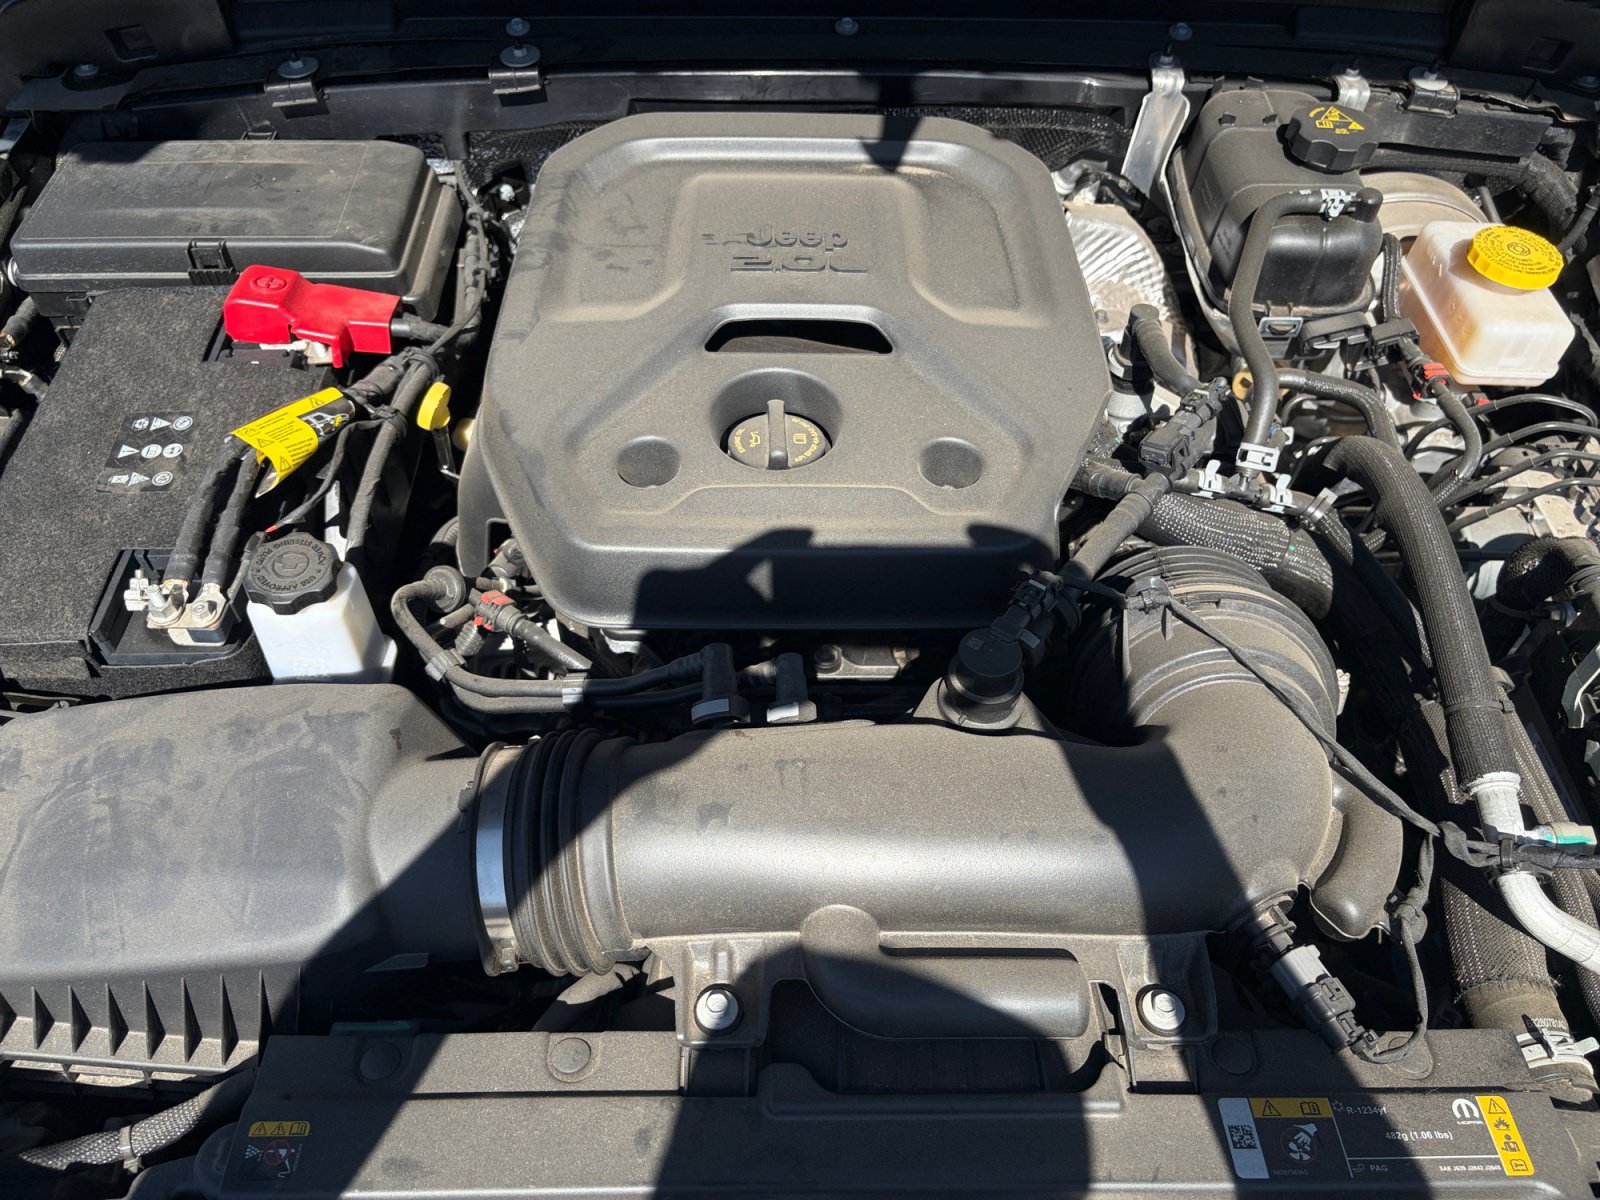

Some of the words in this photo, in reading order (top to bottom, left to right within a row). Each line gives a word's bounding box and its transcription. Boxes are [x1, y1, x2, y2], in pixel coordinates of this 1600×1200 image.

[746, 224, 848, 252] Jeep
[730, 254, 869, 274] 2.0L
[272, 538, 313, 550] STEERING
[257, 575, 299, 592] APPROVED
[1385, 1131, 1409, 1142] 482g
[1410, 1131, 1433, 1140] (1.06
[1434, 1130, 1453, 1140] lbs)
[1369, 1164, 1389, 1172] PAG
